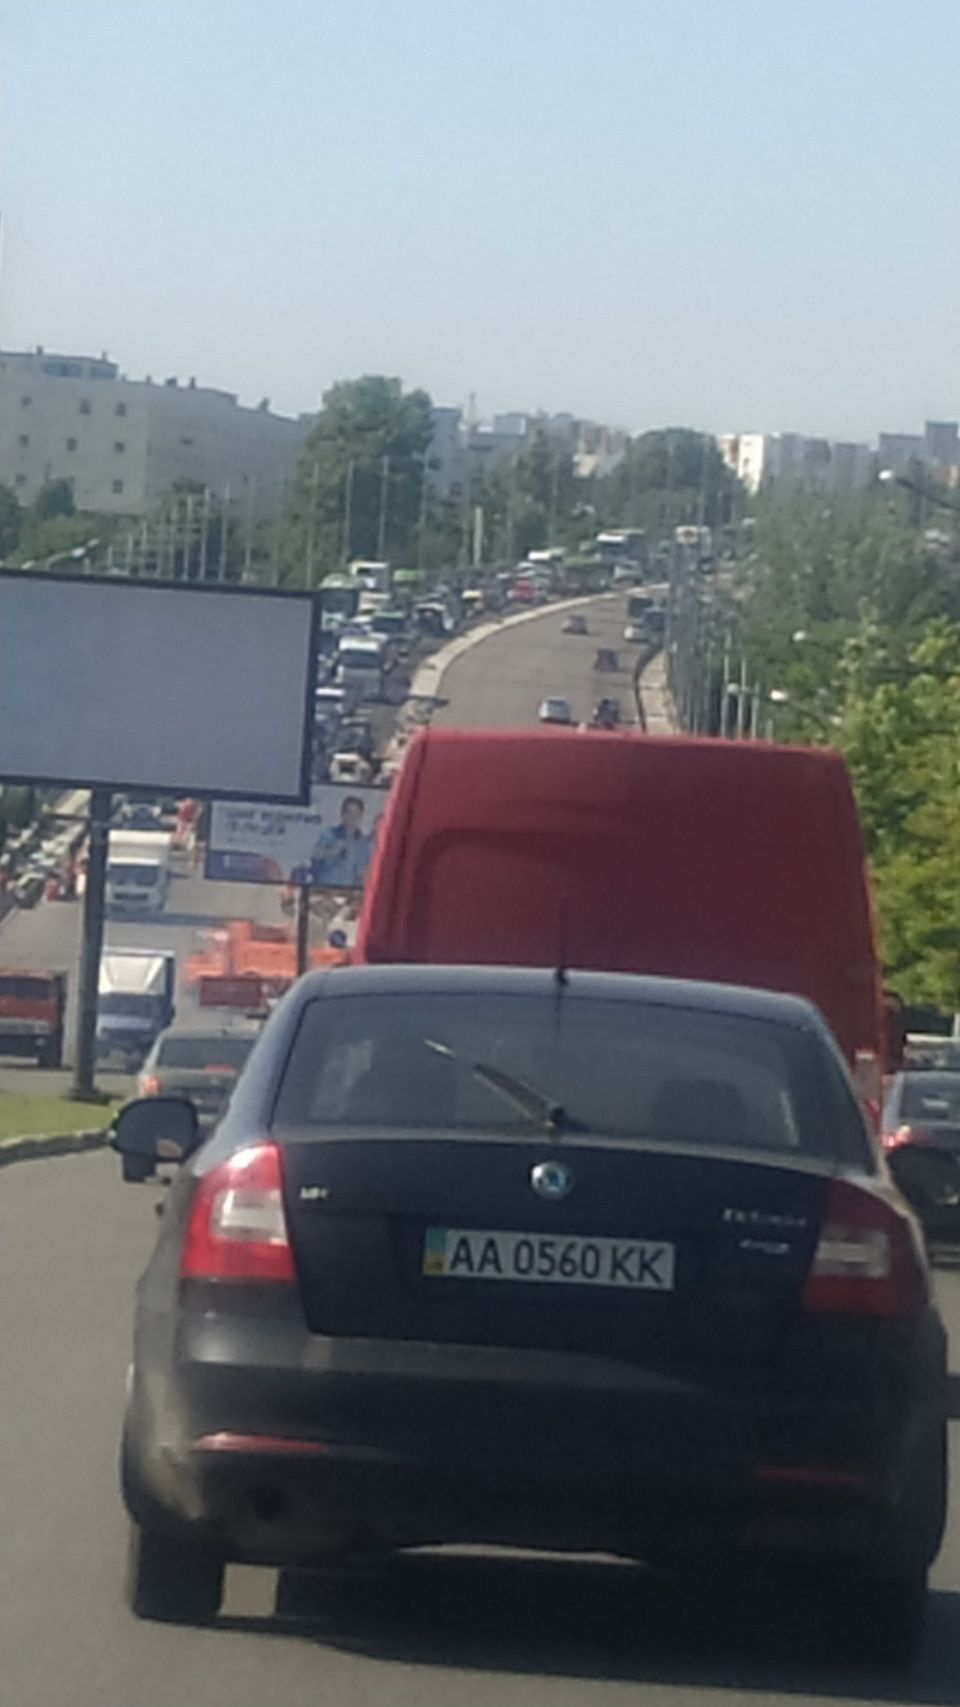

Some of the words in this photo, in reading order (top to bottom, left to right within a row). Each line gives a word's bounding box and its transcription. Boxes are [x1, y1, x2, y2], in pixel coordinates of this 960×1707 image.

[449, 1236, 503, 1274] AA
[514, 1239, 600, 1279] 0560
[610, 1245, 666, 1284] KK
